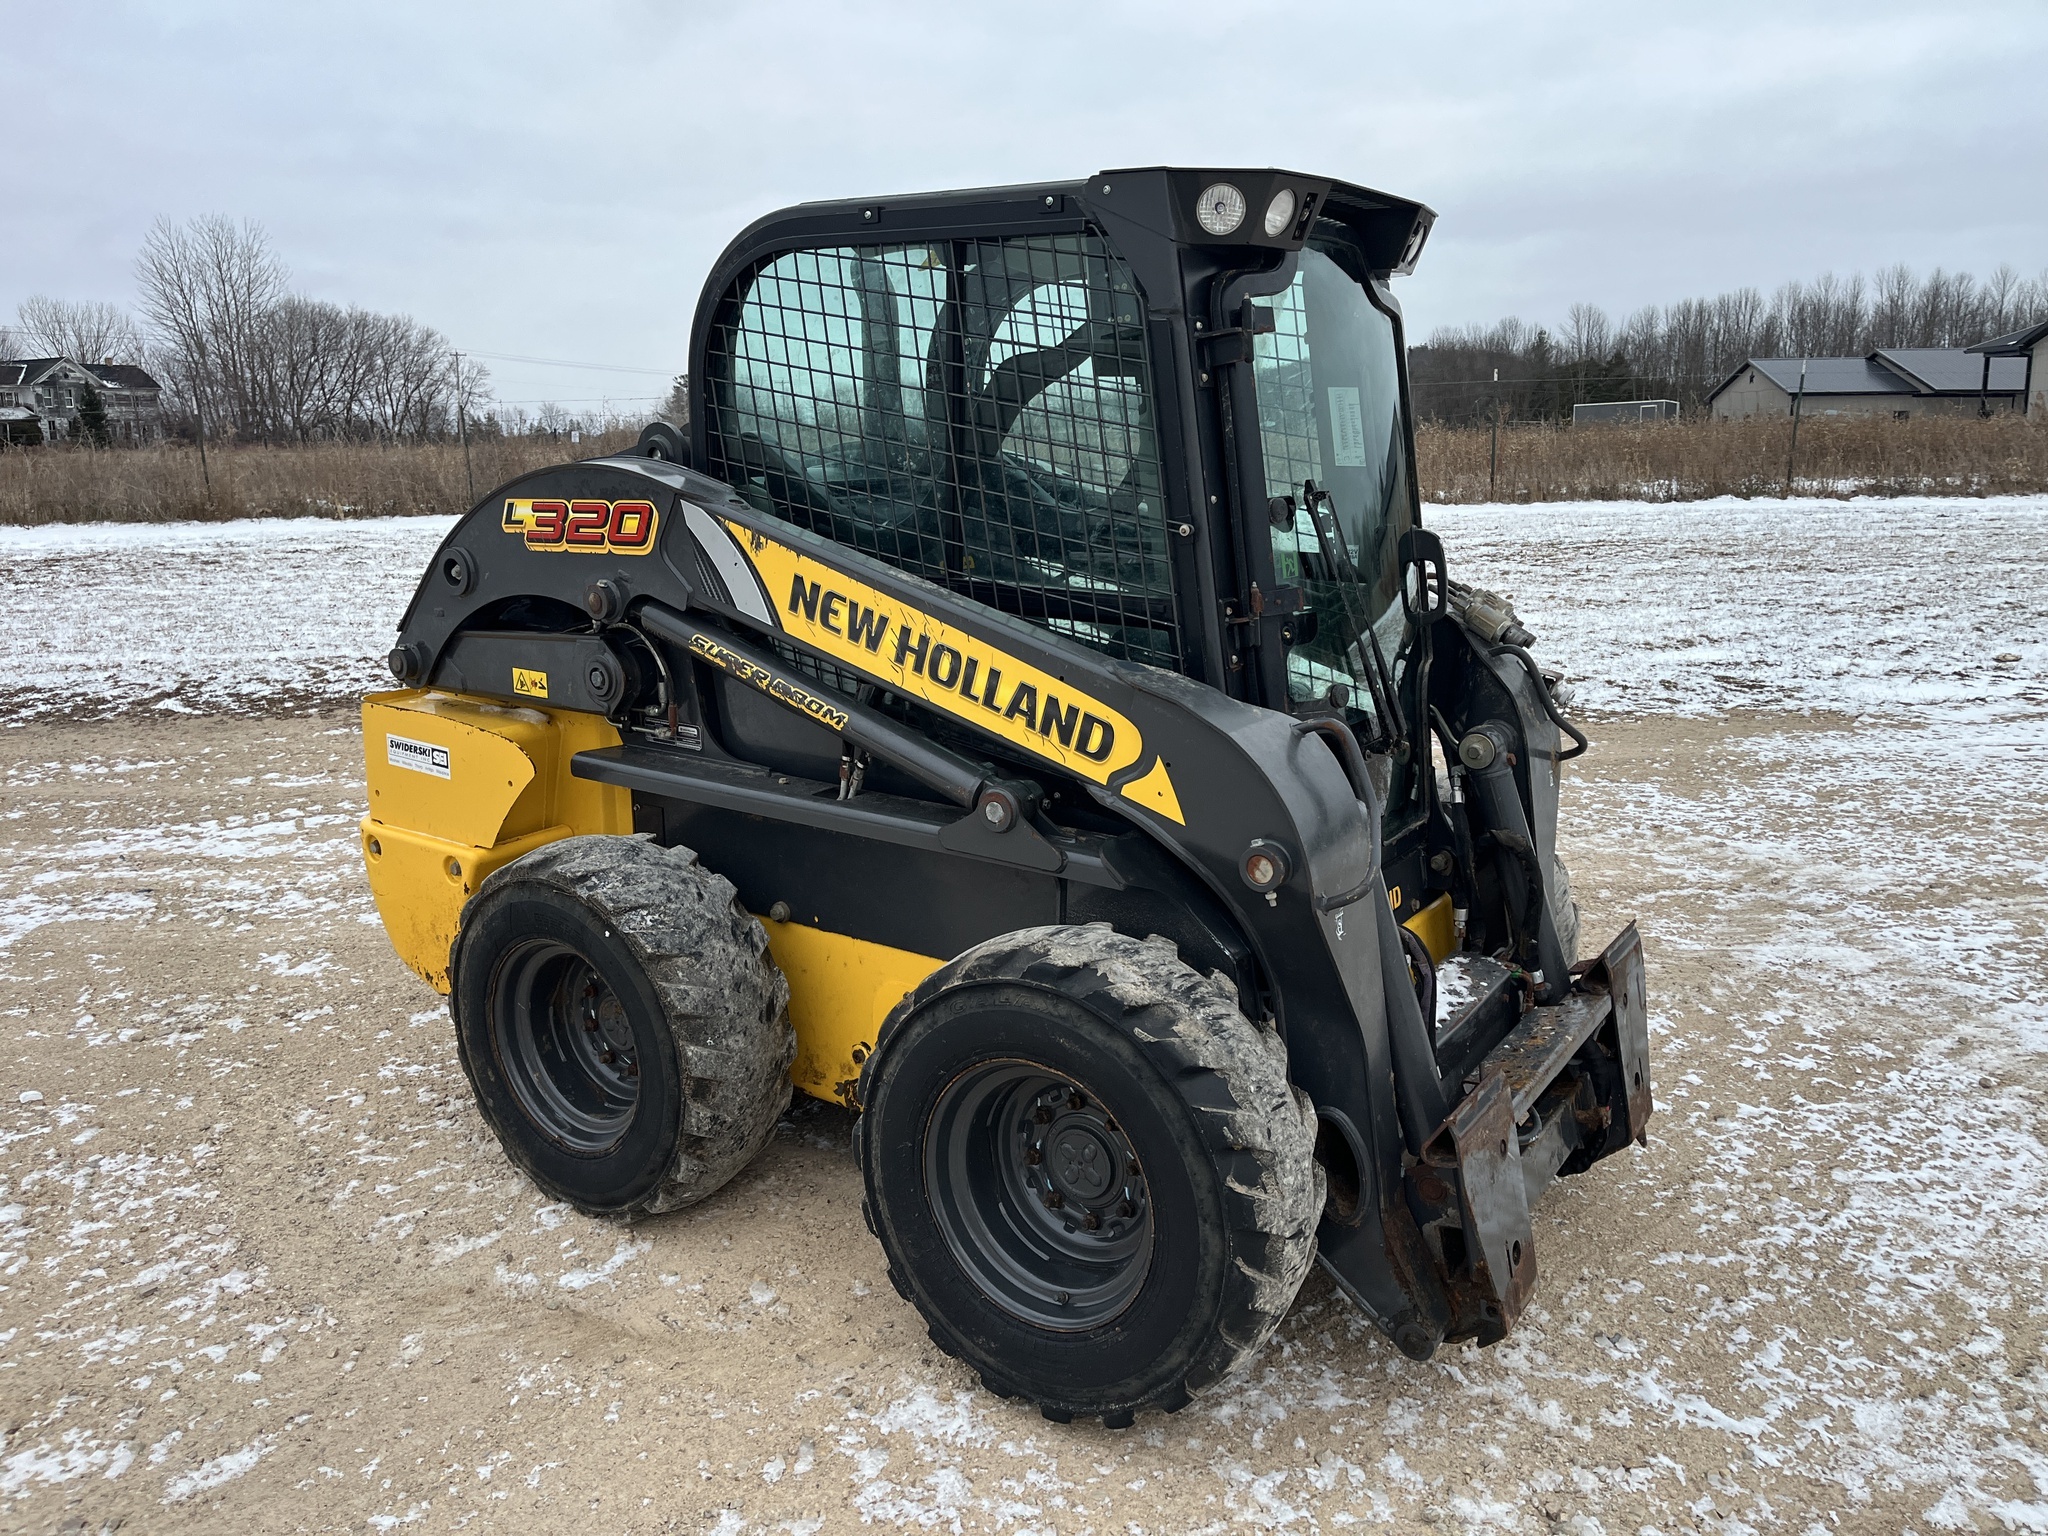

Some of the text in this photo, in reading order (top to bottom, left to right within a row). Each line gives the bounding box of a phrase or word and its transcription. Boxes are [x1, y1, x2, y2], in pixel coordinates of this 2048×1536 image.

[503, 500, 657, 552] L320
[787, 573, 1116, 763] NEW HOLLAND
[389, 740, 431, 758] SWIDERSKI
